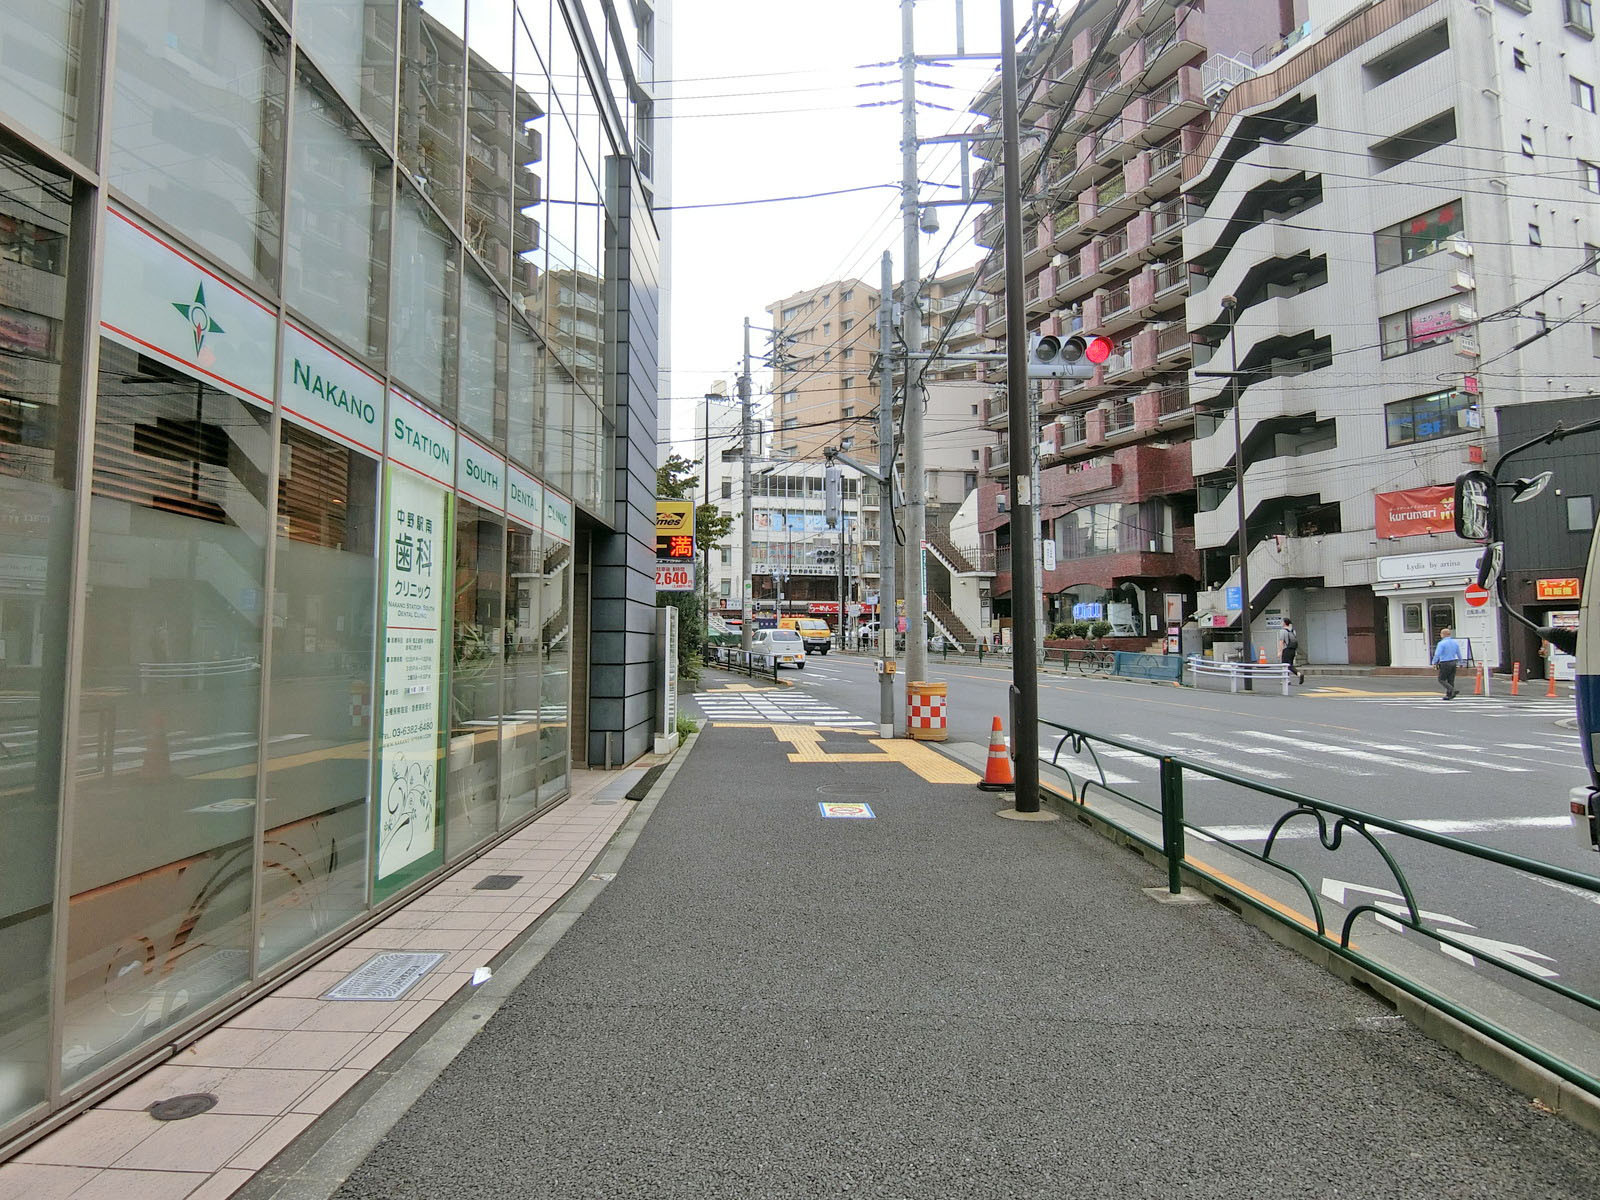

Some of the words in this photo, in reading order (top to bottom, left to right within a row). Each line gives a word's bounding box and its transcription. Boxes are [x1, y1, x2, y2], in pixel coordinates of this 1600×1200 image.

[293, 358, 375, 424] NAKANO
[394, 417, 450, 465] STATION
[466, 458, 498, 490] SOUTH
[511, 483, 538, 512] DENTAL
[547, 505, 567, 527] CLINIC
[397, 508, 432, 535] 中野駅南
[656, 518, 681, 526] imes
[1389, 507, 1437, 522] kurumari
[395, 532, 432, 577] 歯科
[670, 536, 692, 556] 満
[1406, 562, 1425, 571] Lydia
[1429, 561, 1437, 569] by
[395, 579, 431, 600] クリニック
[1540, 580, 1577, 589] ラーメン
[388, 601, 406, 609] NAKANO
